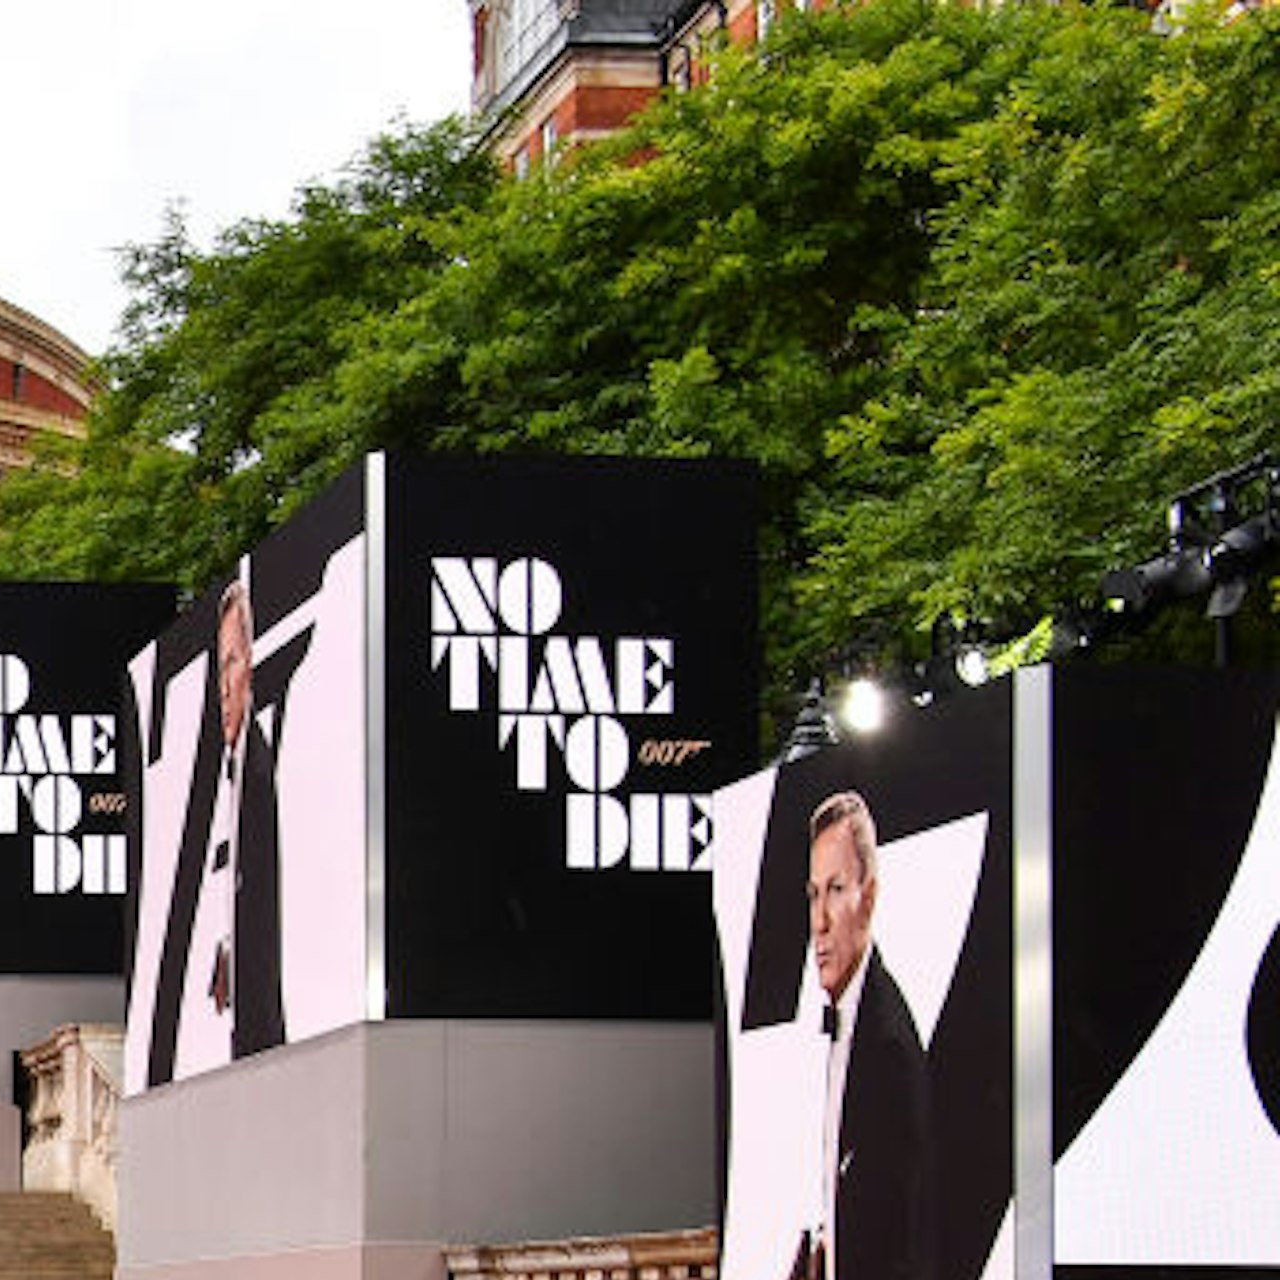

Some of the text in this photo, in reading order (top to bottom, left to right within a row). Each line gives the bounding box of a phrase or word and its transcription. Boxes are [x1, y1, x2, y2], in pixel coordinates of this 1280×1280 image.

[431, 556, 563, 636] NO
[431, 635, 674, 715] TIME
[498, 713, 630, 792] TO
[637, 738, 712, 766] 007
[564, 792, 713, 872] DIE
